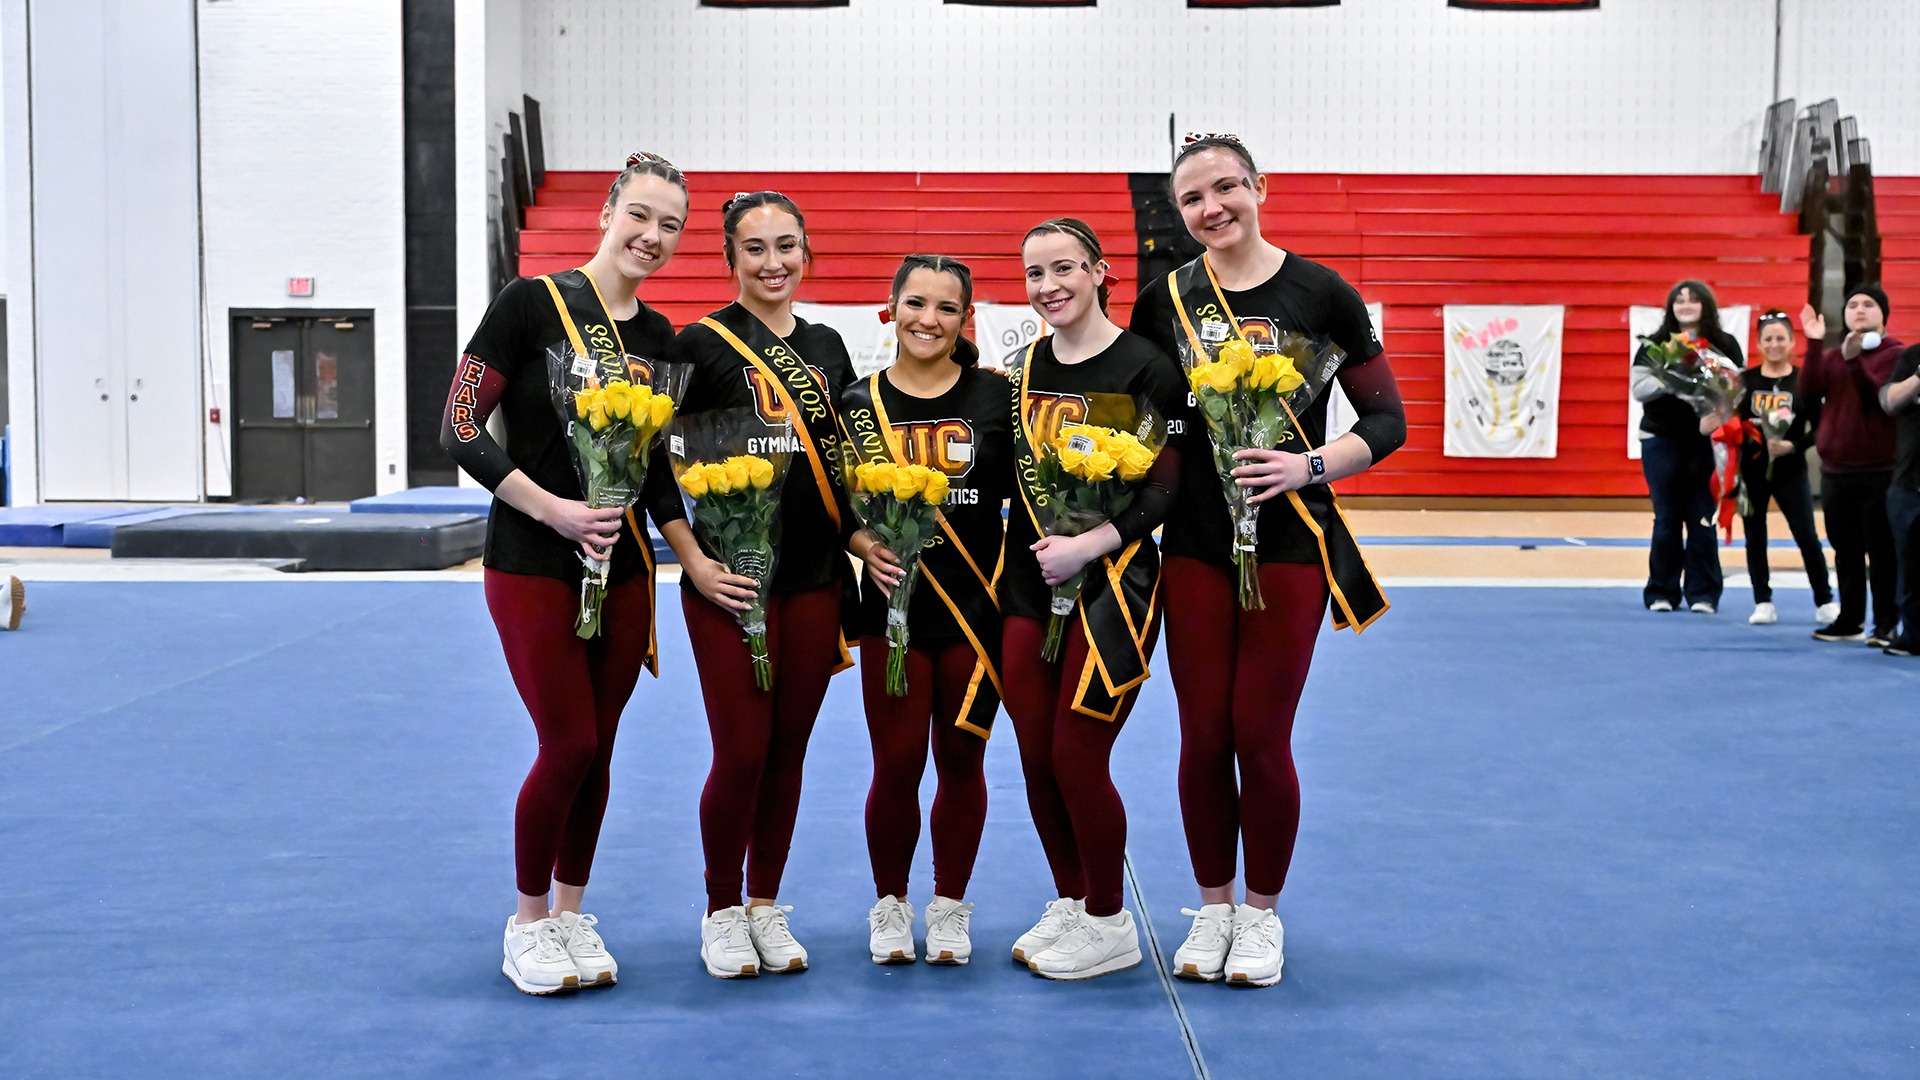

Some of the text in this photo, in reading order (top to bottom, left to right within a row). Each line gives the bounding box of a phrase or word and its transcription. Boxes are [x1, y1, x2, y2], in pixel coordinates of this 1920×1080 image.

[585, 323, 624, 384] SENI
[764, 345, 827, 423] SENIOR
[451, 353, 486, 442] EARS
[850, 408, 890, 464] SENI
[1008, 367, 1050, 507] SENIOR 2026
